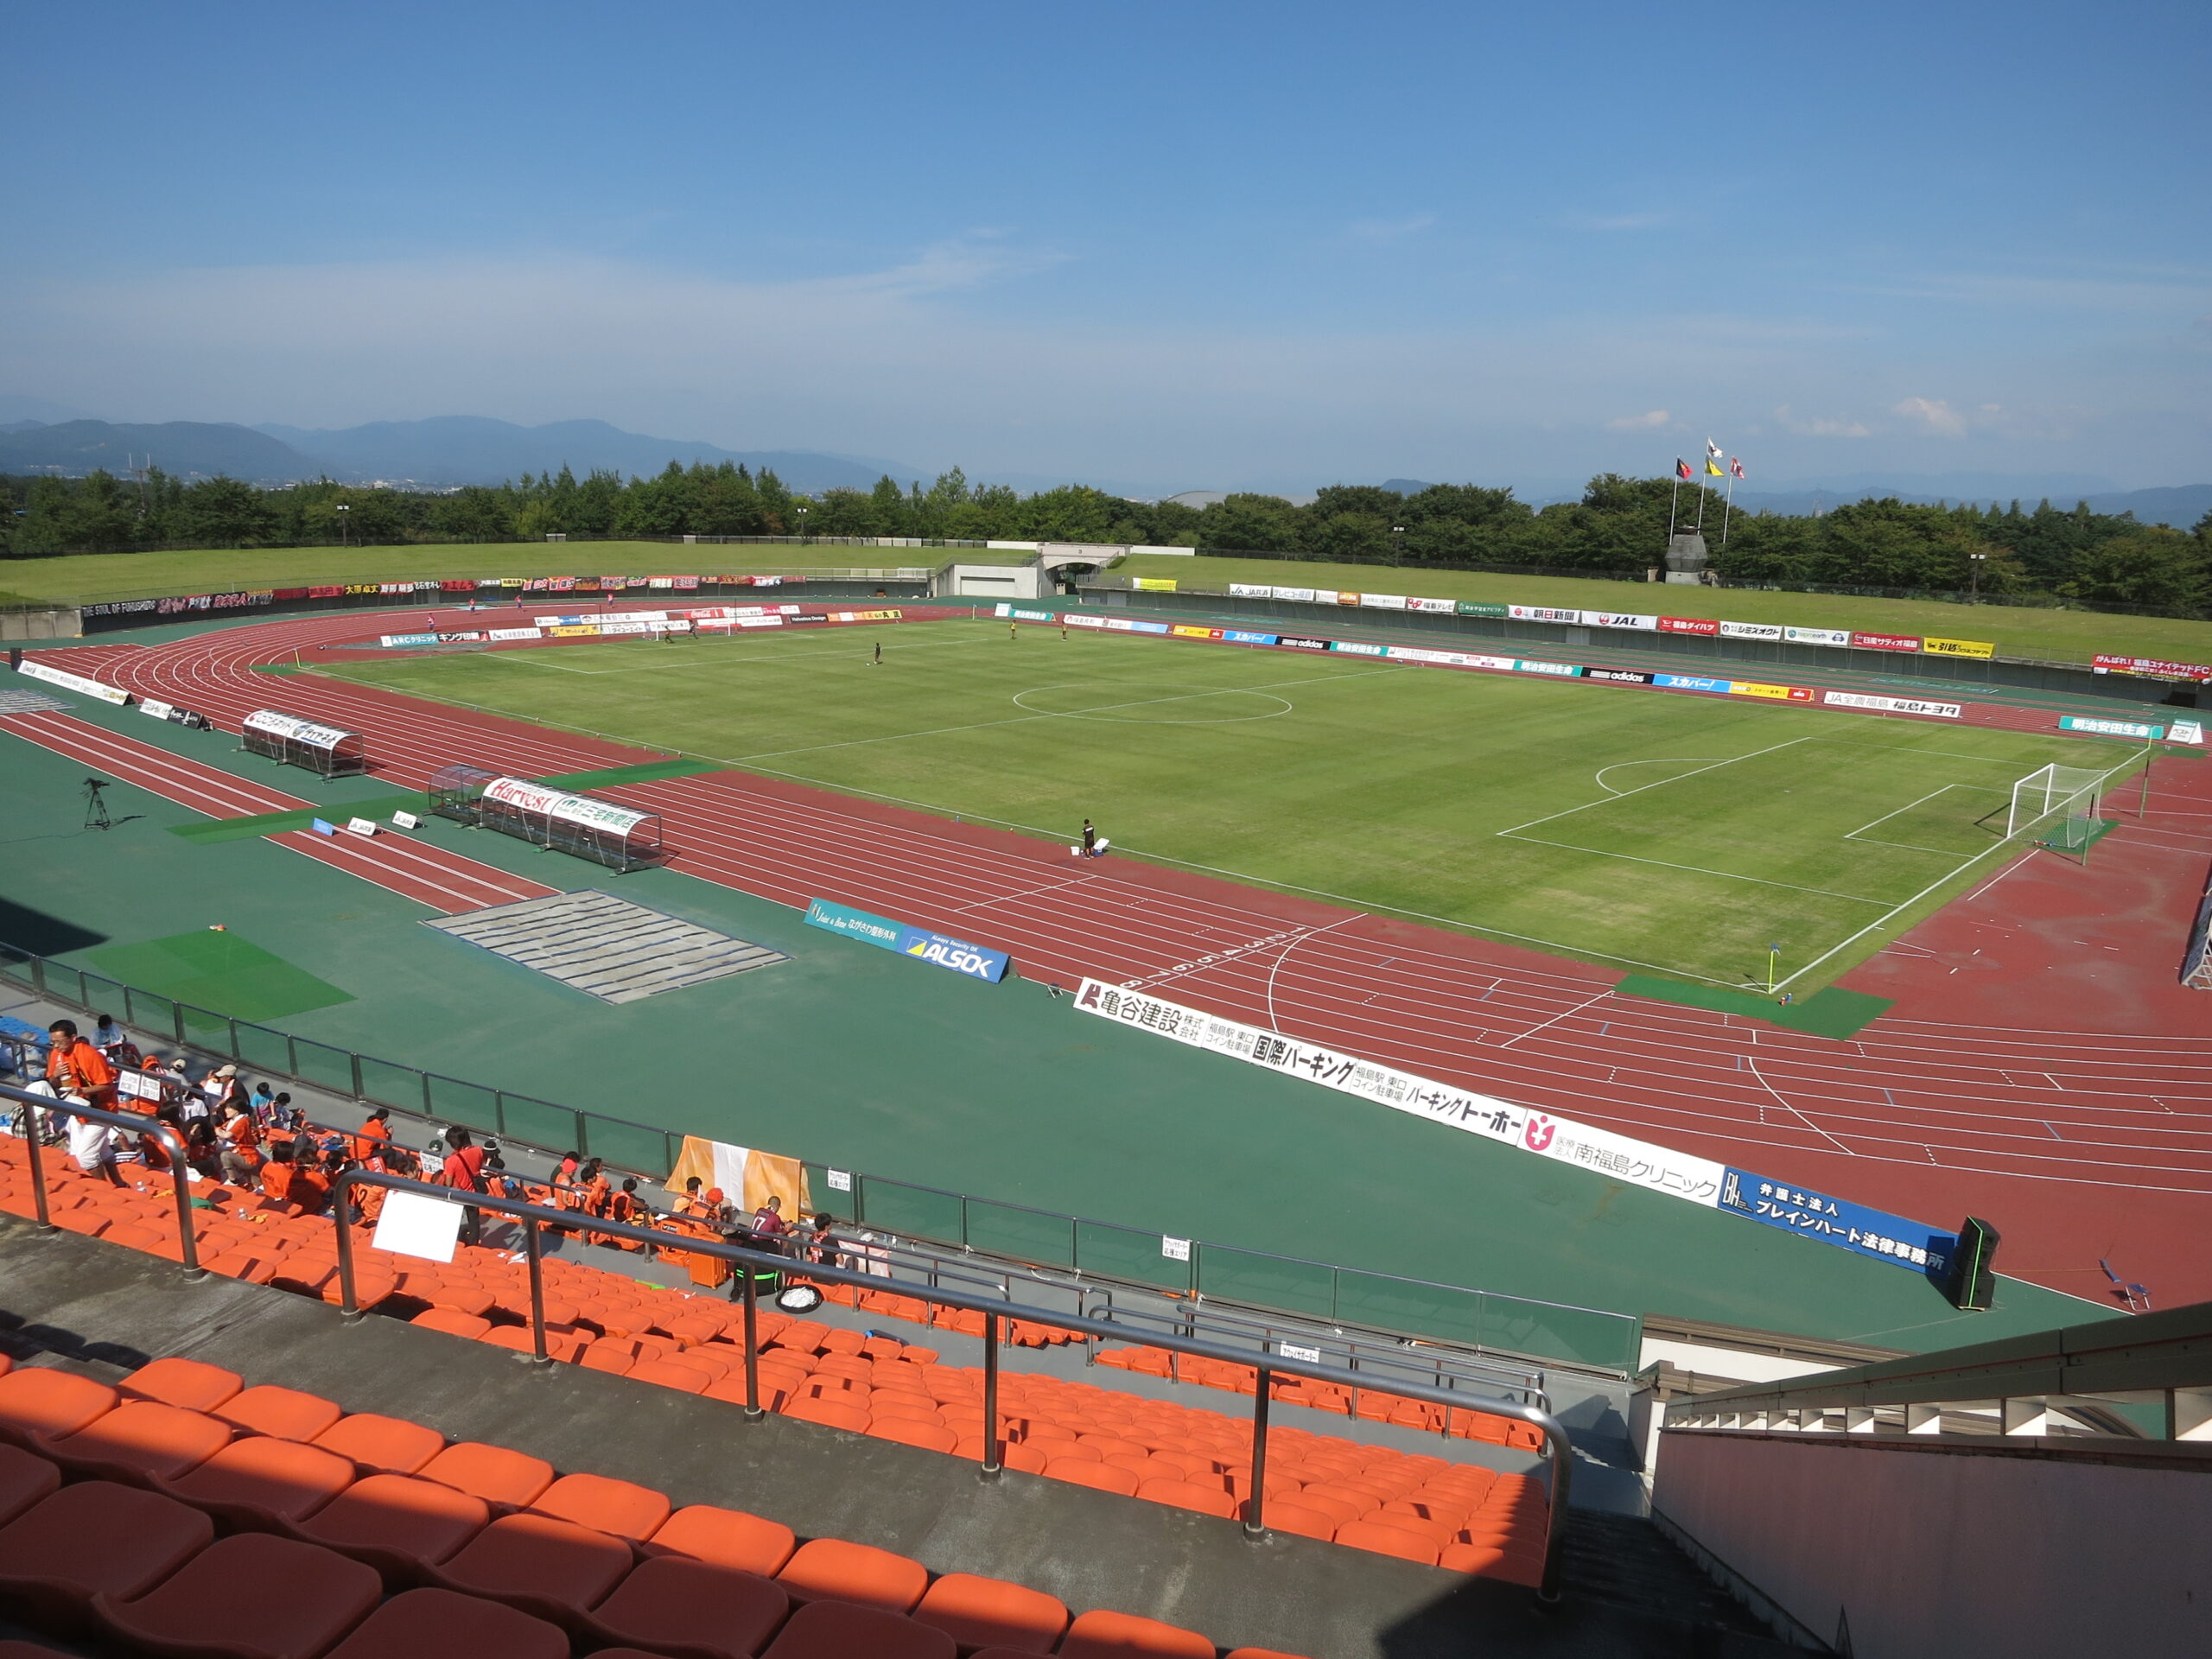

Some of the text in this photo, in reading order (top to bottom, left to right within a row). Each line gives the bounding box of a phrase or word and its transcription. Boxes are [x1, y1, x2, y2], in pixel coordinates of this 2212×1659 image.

[1533, 609, 1575, 621] 朝日新聞
[1611, 616, 1638, 626] JAL
[1673, 620, 1715, 632] 福島ダイハツ
[392, 635, 437, 645] ARCクリニック
[439, 632, 480, 642] キング印刷
[1298, 636, 1324, 649] adidas
[1863, 636, 1918, 648] 日産サティオ福島
[1521, 660, 1573, 676] 明治安田生命
[1611, 671, 1644, 683] adidas
[1827, 692, 1958, 715] JA全農福島 福島トヨタ
[2070, 718, 2151, 737] 明治安田生命
[490, 781, 552, 812] Harvest
[848, 918, 897, 943] ながさわ整形外科
[1265, 933, 1287, 942] 2
[1290, 926, 1306, 935] 1
[1222, 947, 1243, 957] 4
[1244, 940, 1265, 950] 3
[922, 944, 994, 978] ALSOK
[1197, 955, 1220, 964] 5
[1147, 970, 1171, 979] 7
[1173, 963, 1194, 972] 6
[1120, 979, 1143, 988] 8
[1101, 990, 1183, 1036] 亀谷建設
[1183, 1014, 1205, 1031] 株式
[1179, 1026, 1200, 1042] 会社
[1209, 1023, 1255, 1045] 福島駅 東口
[1205, 1033, 1252, 1055] コイン駐車場
[1252, 1035, 1357, 1086] 国際パーキング
[1356, 1066, 1408, 1091] 福島駅 東口
[1352, 1078, 1403, 1103] コイン駐車場
[1554, 1146, 1573, 1161] 法人
[1574, 1141, 1717, 1198] 南福島クリニック
[1758, 1181, 1839, 1217] 弁護士法人
[751, 1217, 766, 1232] 17
[1756, 1199, 1946, 1271] ブレインハート法律事務所
[1164, 1248, 1187, 1259] 応援エリア
[1282, 1347, 1318, 1361] アウェイサポーター
